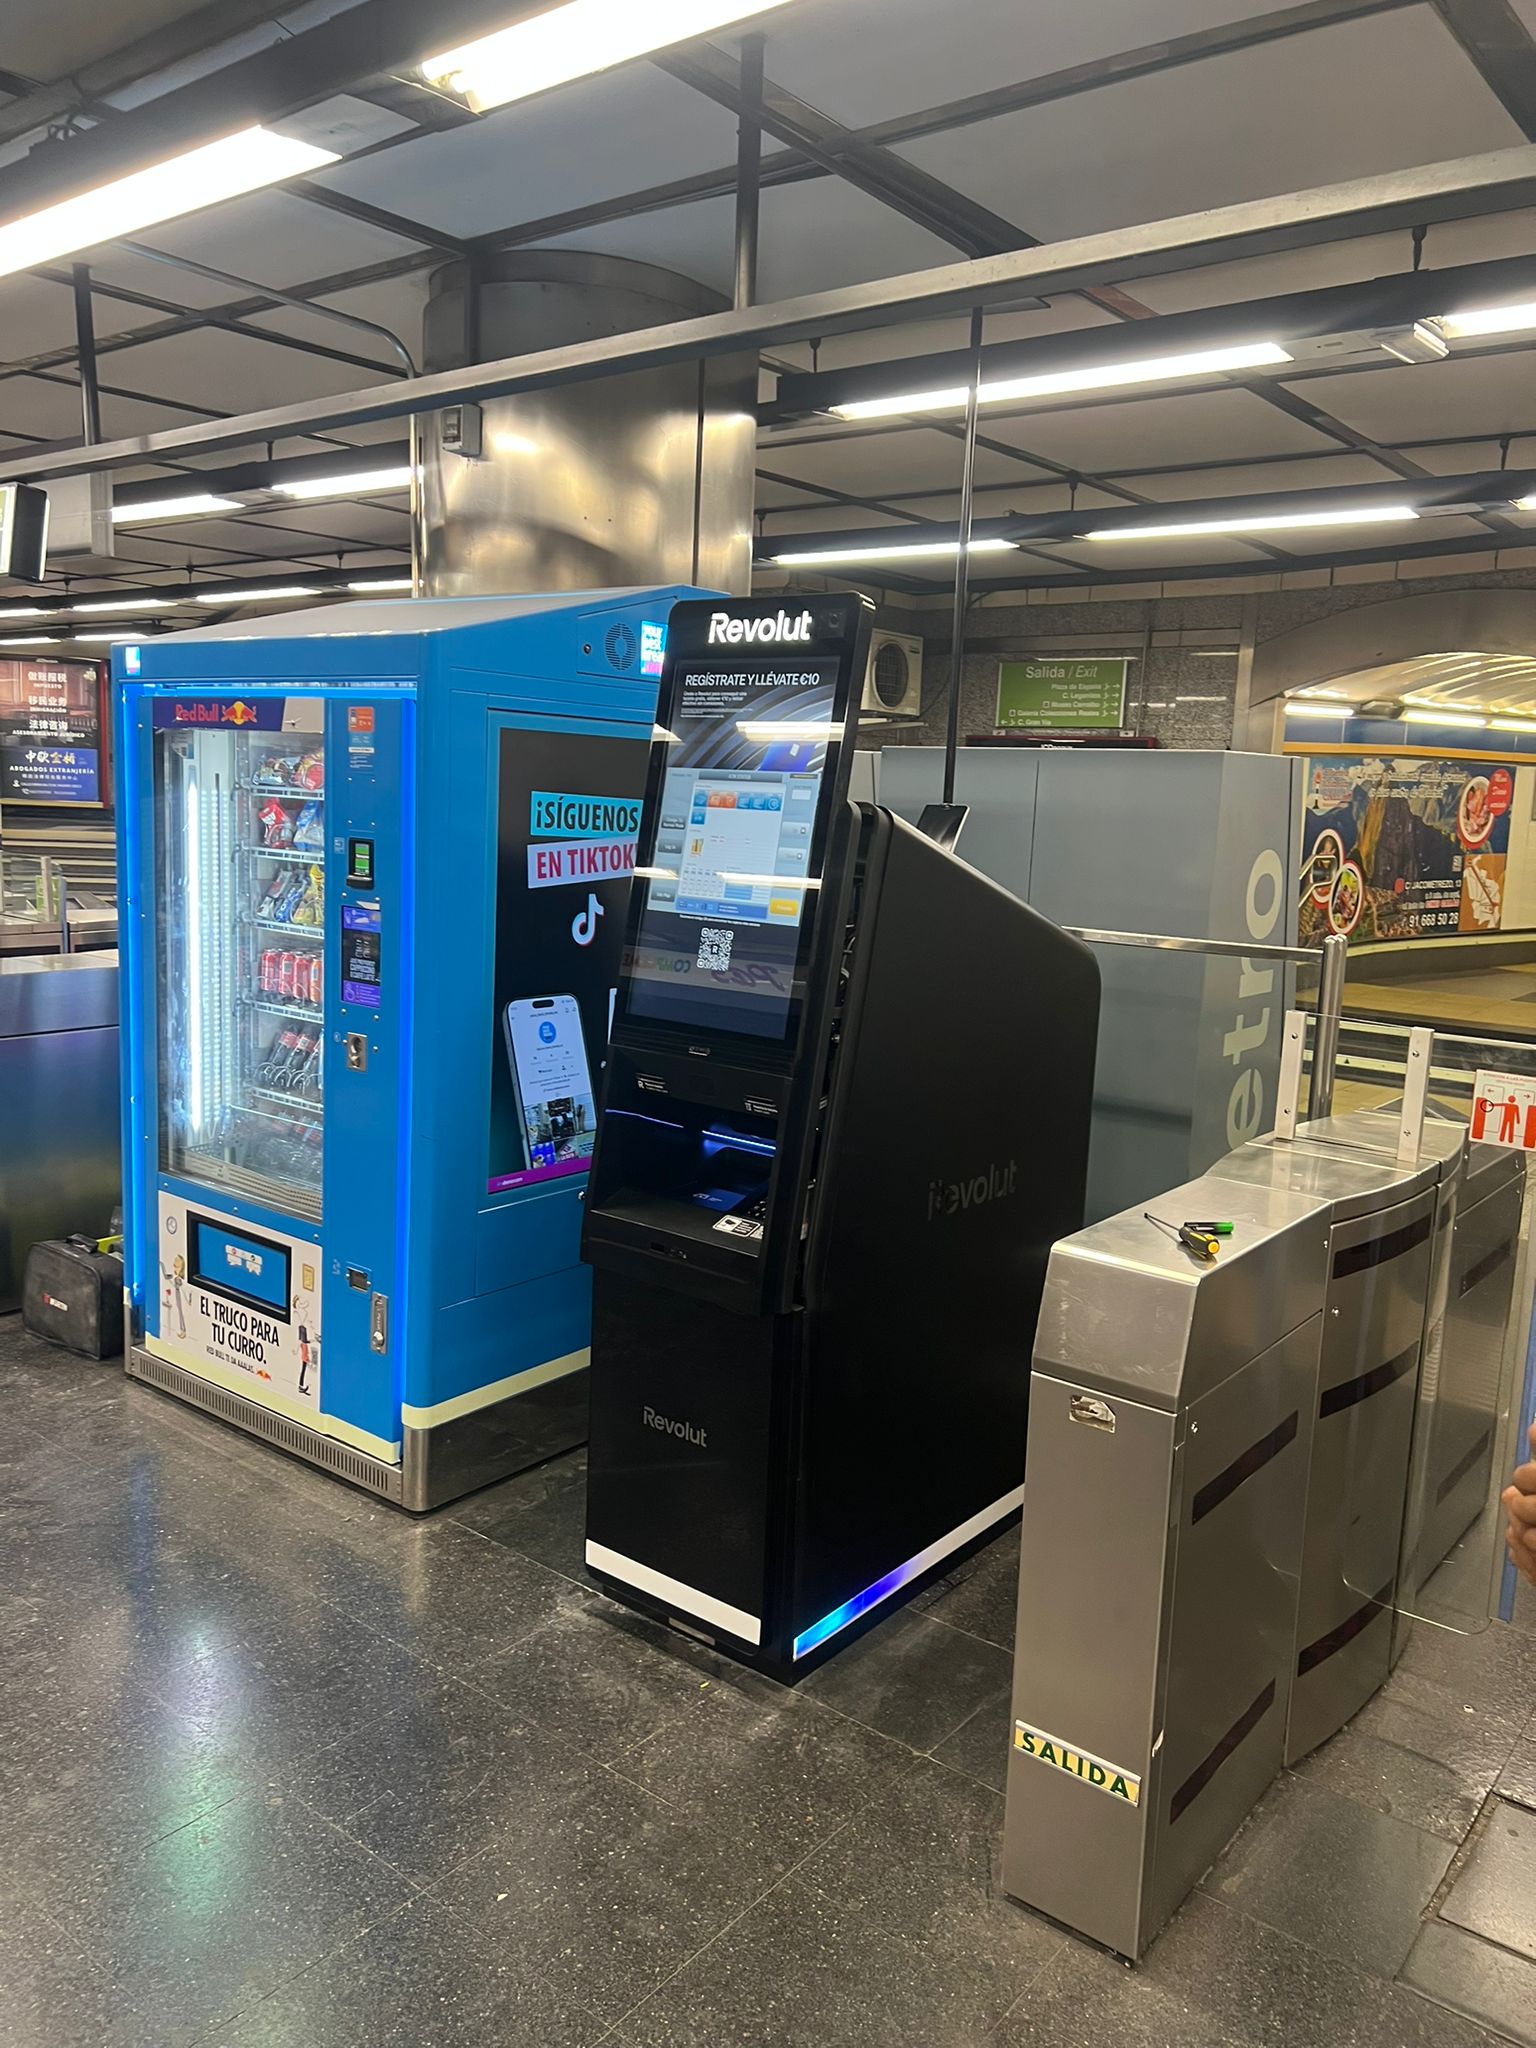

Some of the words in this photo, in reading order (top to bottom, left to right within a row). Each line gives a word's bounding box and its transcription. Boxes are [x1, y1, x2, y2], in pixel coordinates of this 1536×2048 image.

[708, 610, 813, 644] Revolut
[685, 671, 747, 687] REGÍSTRATE
[747, 673, 756, 686] Y
[755, 670, 800, 686] LLÉVATE
[800, 673, 820, 686] €10
[1025, 666, 1065, 679] Salida
[1075, 665, 1098, 678] Exit
[176, 703, 197, 721] Red
[197, 703, 219, 721] Bull
[9, 765, 48, 773] ABOGADOS
[49, 767, 95, 775] EXTRANJERÍA
[536, 796, 639, 832] ¡SÍGUENOS
[537, 850, 562, 879] EN
[1409, 915, 1419, 927] 91
[1437, 912, 1448, 925] 50
[200, 1295, 211, 1317] EL
[213, 1301, 248, 1332] TRUCO
[251, 1316, 280, 1347] PARA
[211, 1322, 225, 1345] TU
[228, 1331, 267, 1364] CURRO.
[643, 1406, 707, 1448] Revolut
[1022, 1732, 1130, 1799] SALIDA
